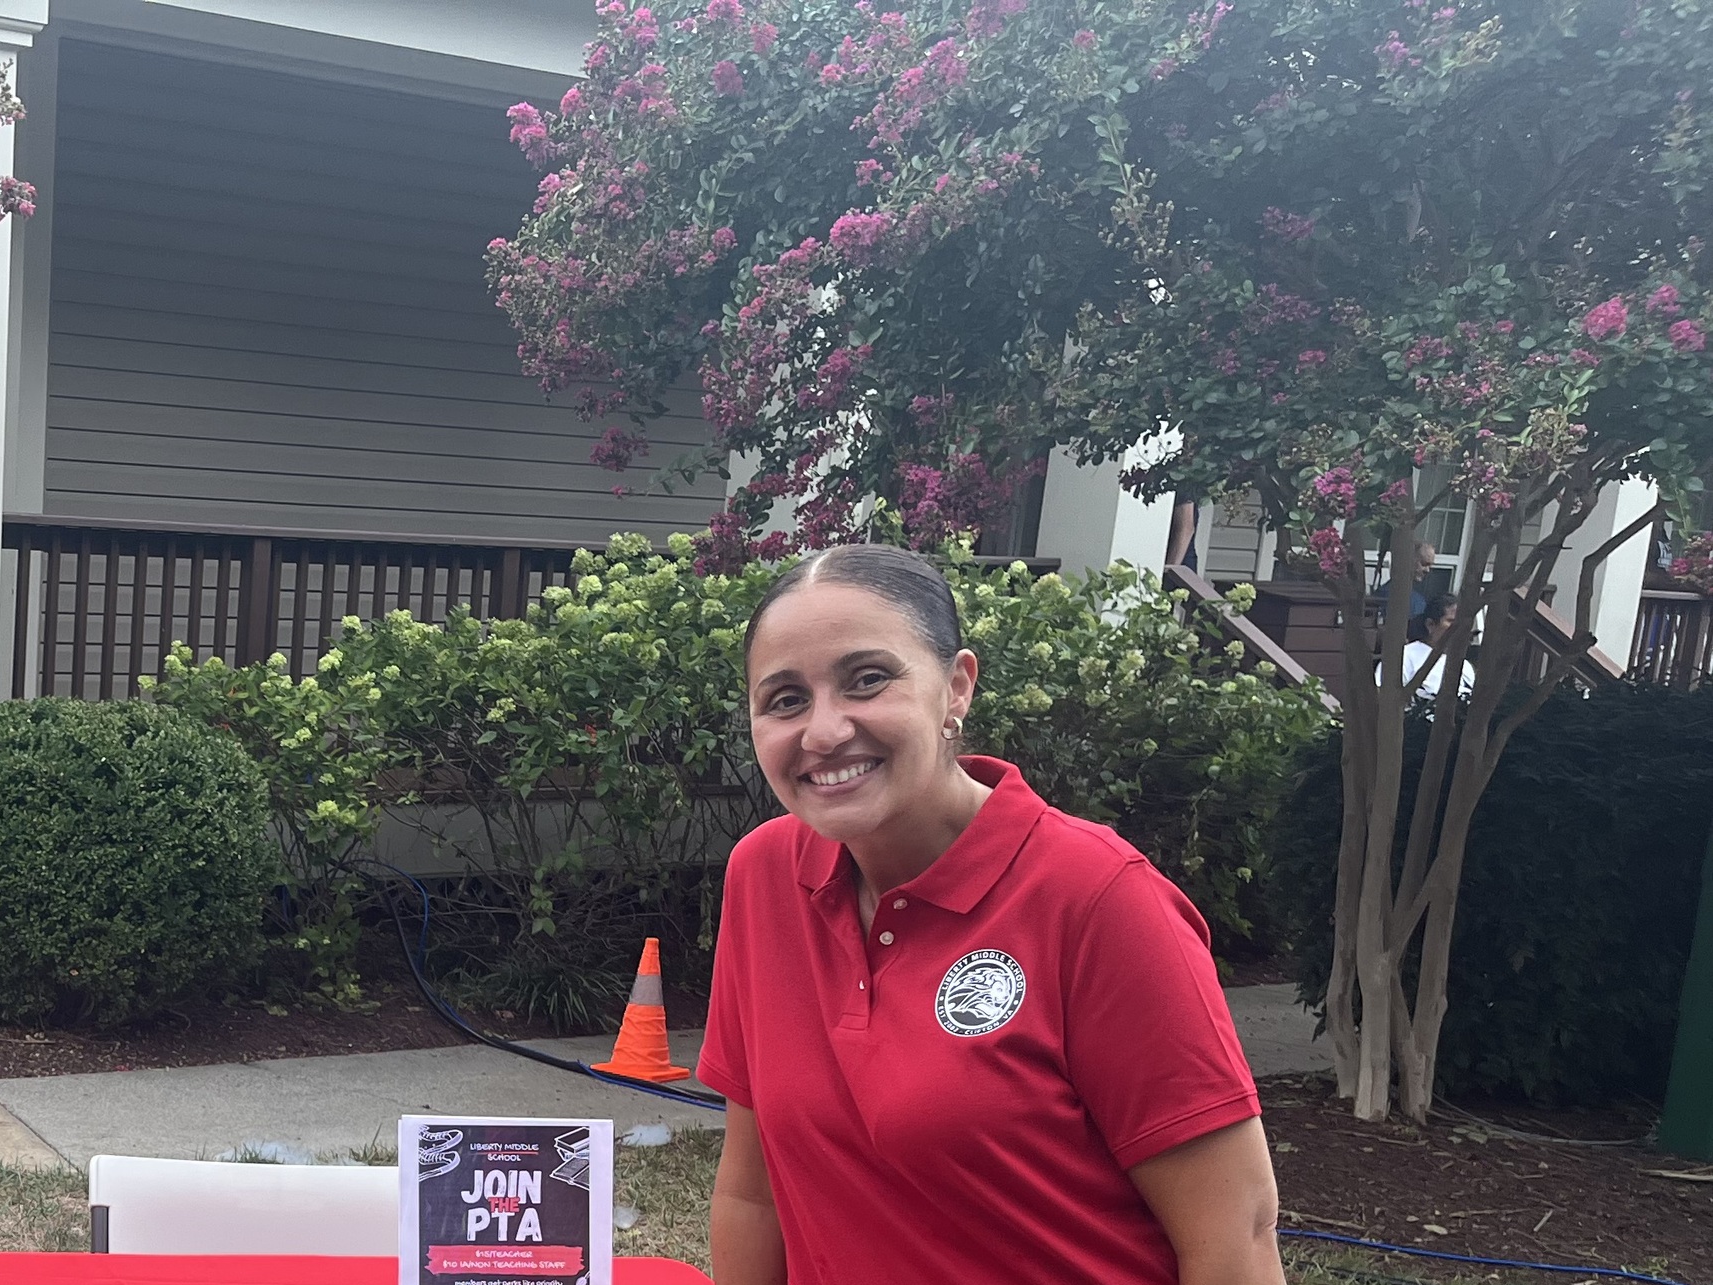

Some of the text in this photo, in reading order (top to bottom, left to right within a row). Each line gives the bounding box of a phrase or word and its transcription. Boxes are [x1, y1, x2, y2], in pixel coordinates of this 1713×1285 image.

[942, 951, 1024, 993] LIBERTY MIDDLE SCHOOL
[470, 1143, 539, 1151] LIBERTY MIDDLE
[487, 1153, 522, 1162] SCHOOL
[460, 1169, 542, 1204] JOIN
[487, 1197, 520, 1213] THE
[466, 1207, 543, 1242] PTA
[493, 1261, 538, 1269] TEACHING
[539, 1261, 566, 1269] STAFF
